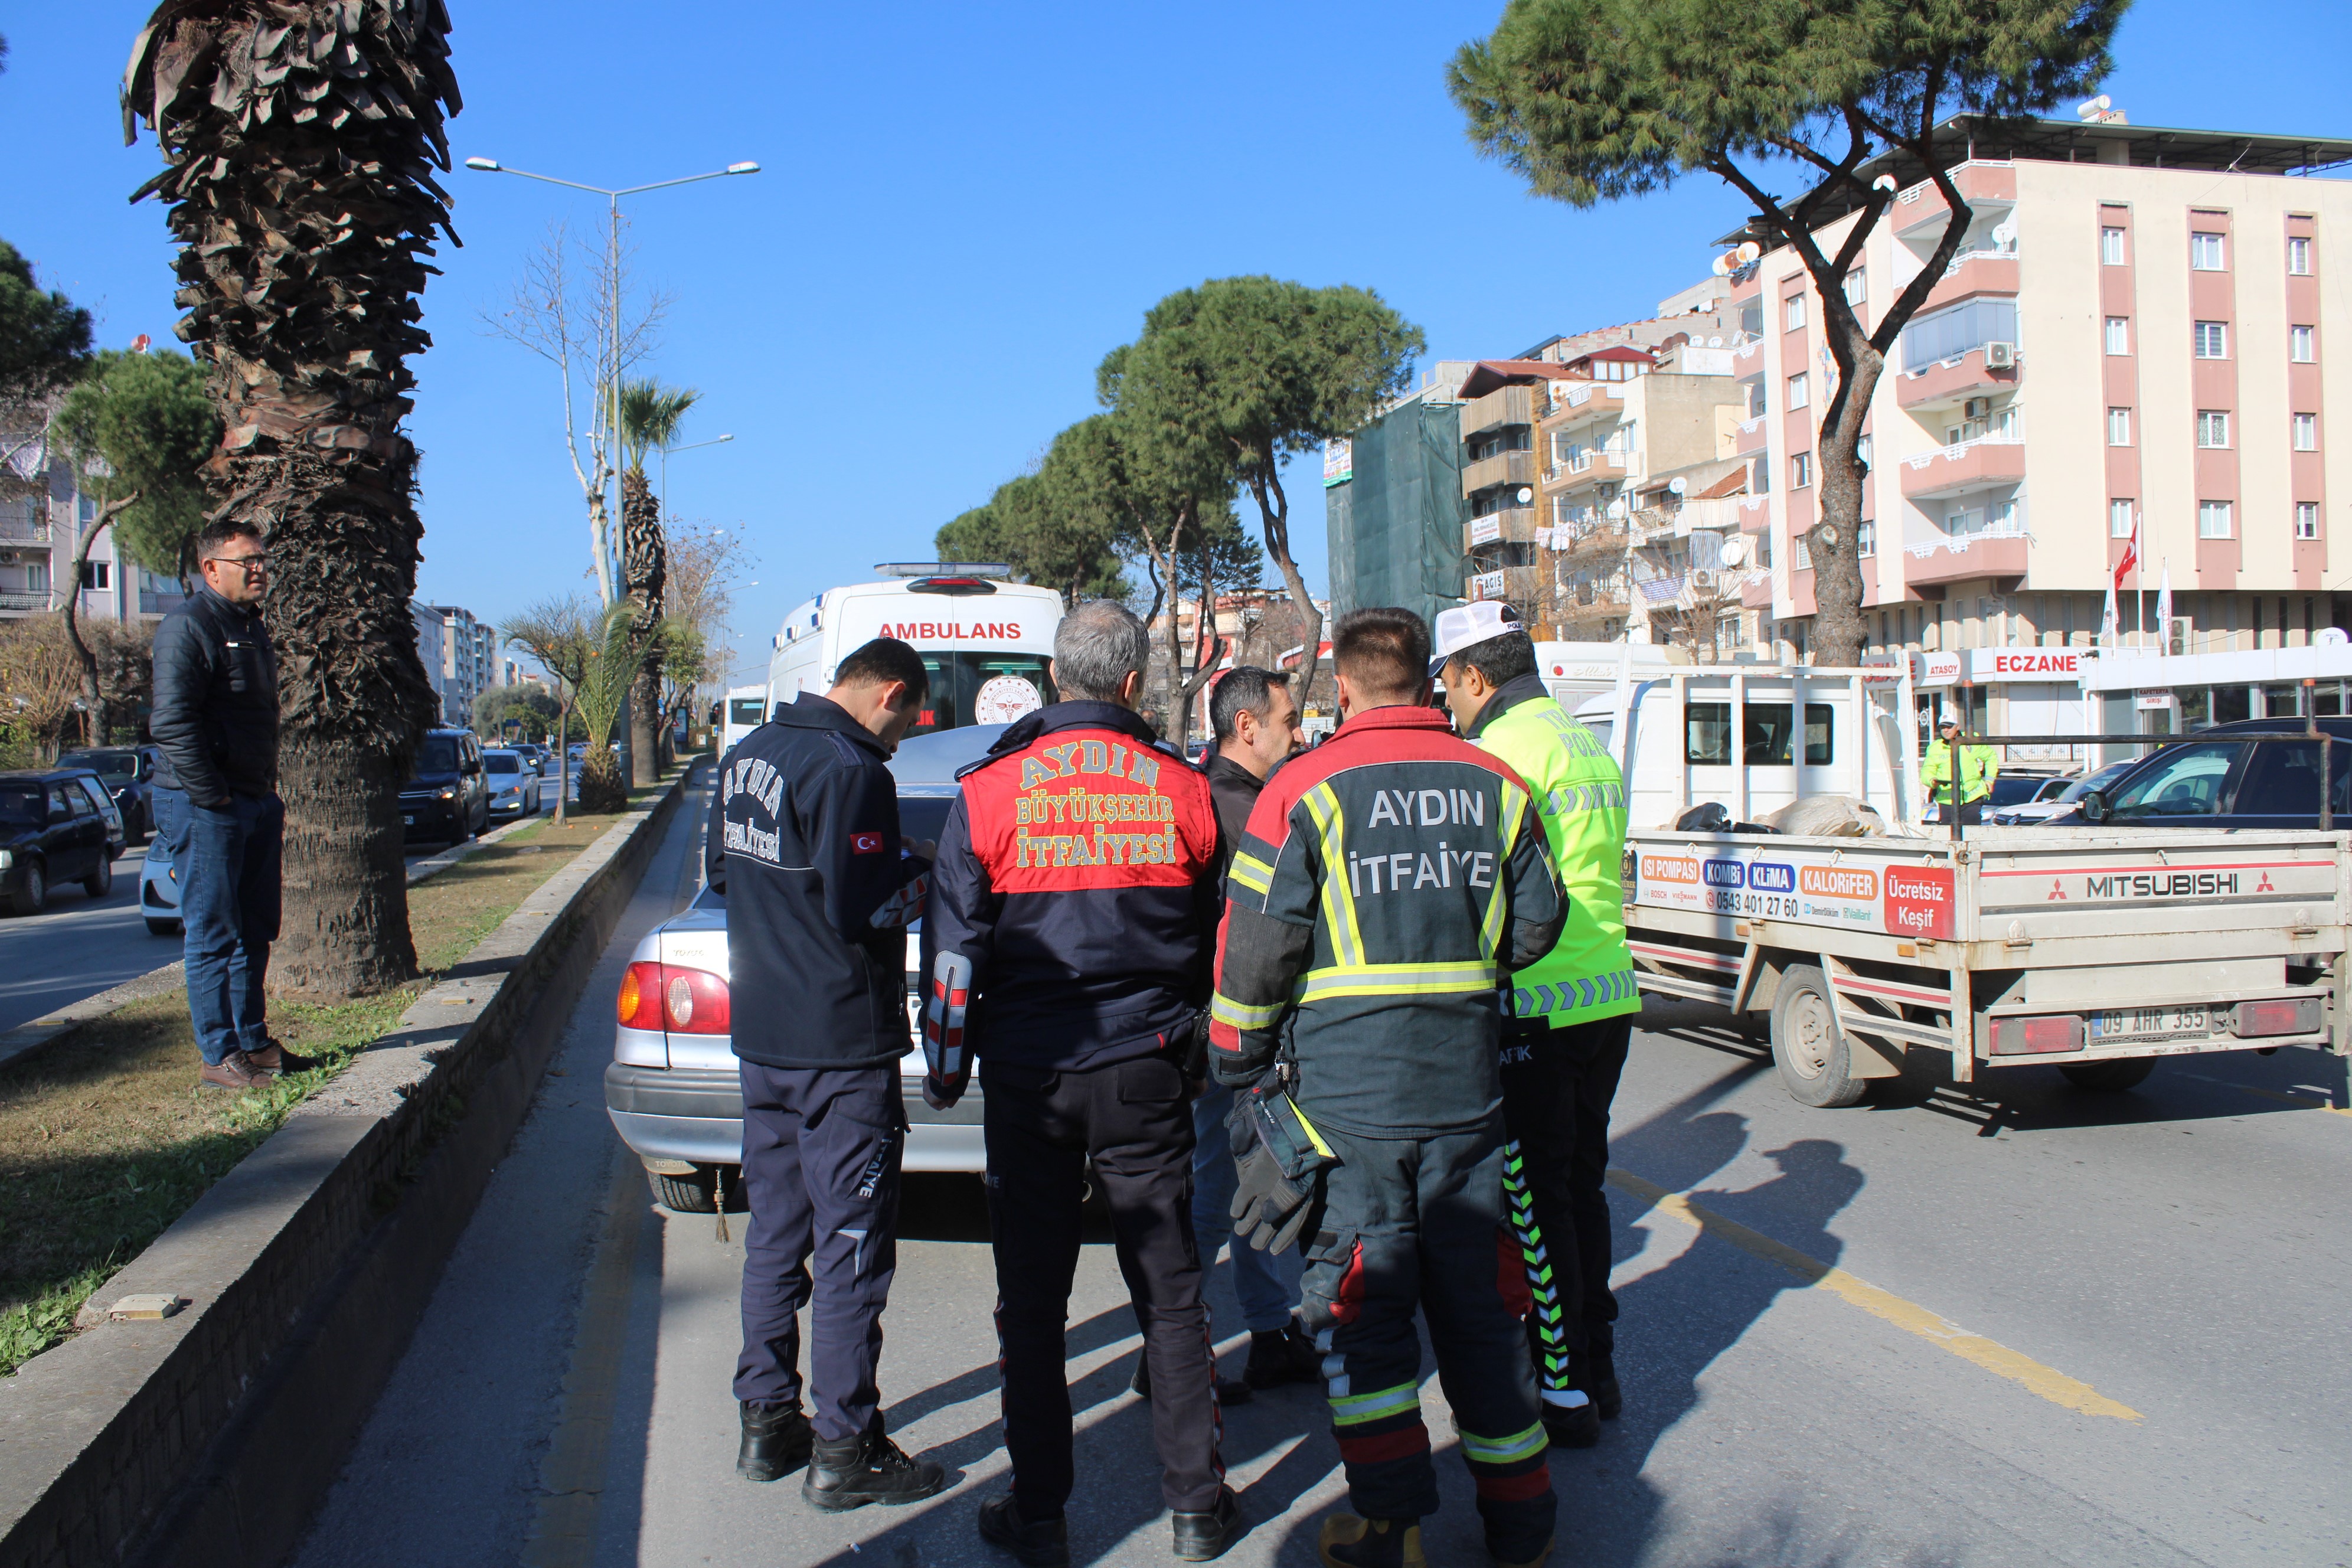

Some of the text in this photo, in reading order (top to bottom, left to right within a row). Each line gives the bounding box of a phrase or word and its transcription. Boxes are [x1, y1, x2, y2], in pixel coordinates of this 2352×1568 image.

[878, 623, 1021, 639] AMBULANS
[1930, 665, 1958, 675] ATASOY
[1996, 655, 2077, 672] ECZANE
[1020, 740, 1160, 791] AYDIN
[723, 757, 784, 821] AYDIN
[1015, 787, 1175, 824] BÜYÜKŞEHİR
[1368, 788, 1484, 828] AYDIN
[1017, 824, 1176, 868] İTFAİYESİ
[1349, 841, 1493, 897] İTFAİYE
[1644, 858, 1697, 880] ISI POMPASI
[1651, 890, 1667, 899] BOSCH
[1889, 875, 1944, 901] Ücretsiz
[2087, 873, 2237, 898] MITSUBISHI
[1717, 892, 1798, 918] 0543 401 27 60
[1848, 907, 1871, 921] Vaillant
[1899, 906, 1934, 931] Keşif
[2103, 1007, 2204, 1034] 09 AHR 355
